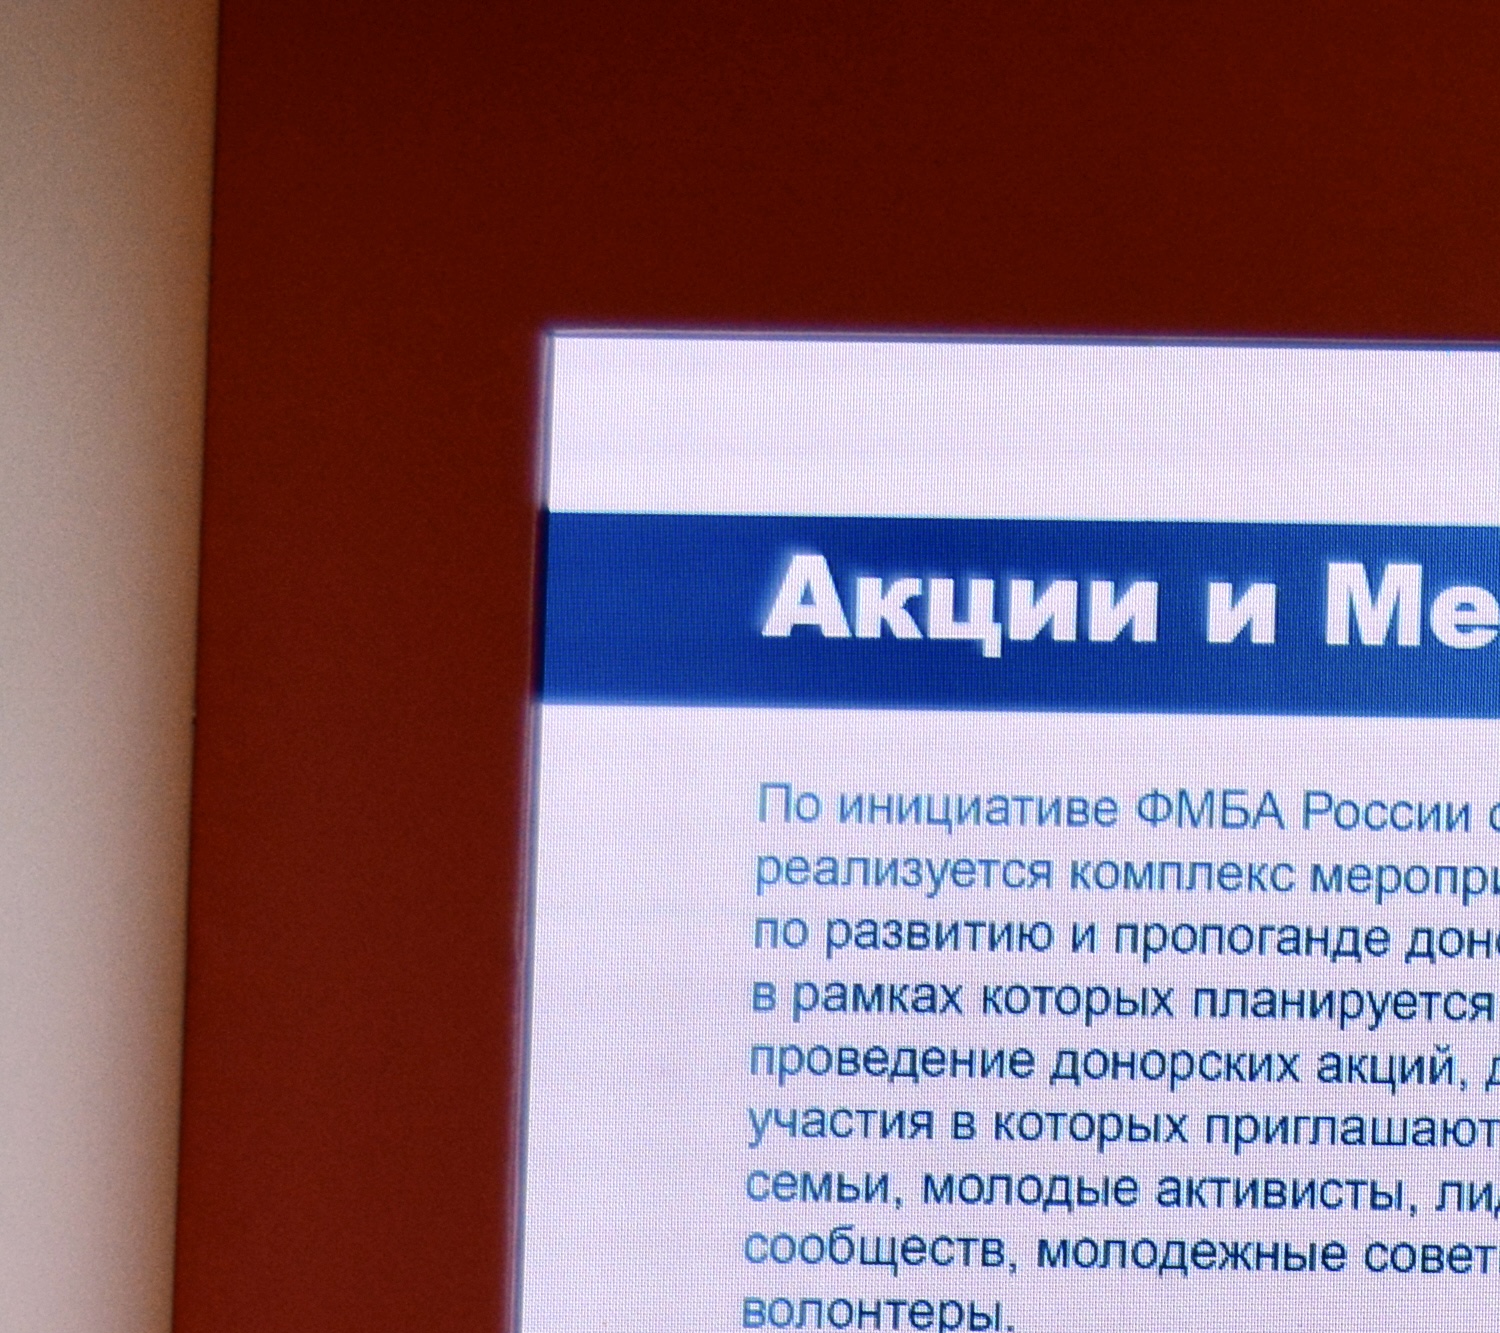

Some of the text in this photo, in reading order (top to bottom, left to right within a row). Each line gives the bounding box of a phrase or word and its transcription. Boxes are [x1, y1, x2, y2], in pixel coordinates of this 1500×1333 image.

[761, 554, 1159, 658] Акции
[1206, 581, 1277, 644] и
[757, 781, 822, 823] По
[838, 793, 1119, 834] инициативе
[1136, 787, 1287, 830] ФМБА
[1301, 789, 1472, 835] России
[755, 853, 1054, 898] реализуется
[1070, 859, 1297, 893] комплекс
[754, 917, 809, 949] по
[826, 917, 1055, 959] развитию
[1071, 921, 1098, 953] и
[1115, 921, 1391, 963] пропоганде
[752, 980, 1496, 1031] в рамках которых планируется
[750, 1043, 1036, 1087] проведение
[1048, 1048, 1301, 1092] донорских
[1317, 1042, 1468, 1096] акций,
[745, 1106, 935, 1148] участия
[952, 1110, 976, 1141] в
[994, 1110, 1189, 1153] которых
[745, 1169, 903, 1209] семьи,
[923, 1172, 1139, 1212] молодые
[1156, 1175, 1419, 1218] активисты,
[743, 1224, 1018, 1277] сообществ,
[1038, 1235, 1348, 1277] молодежные
